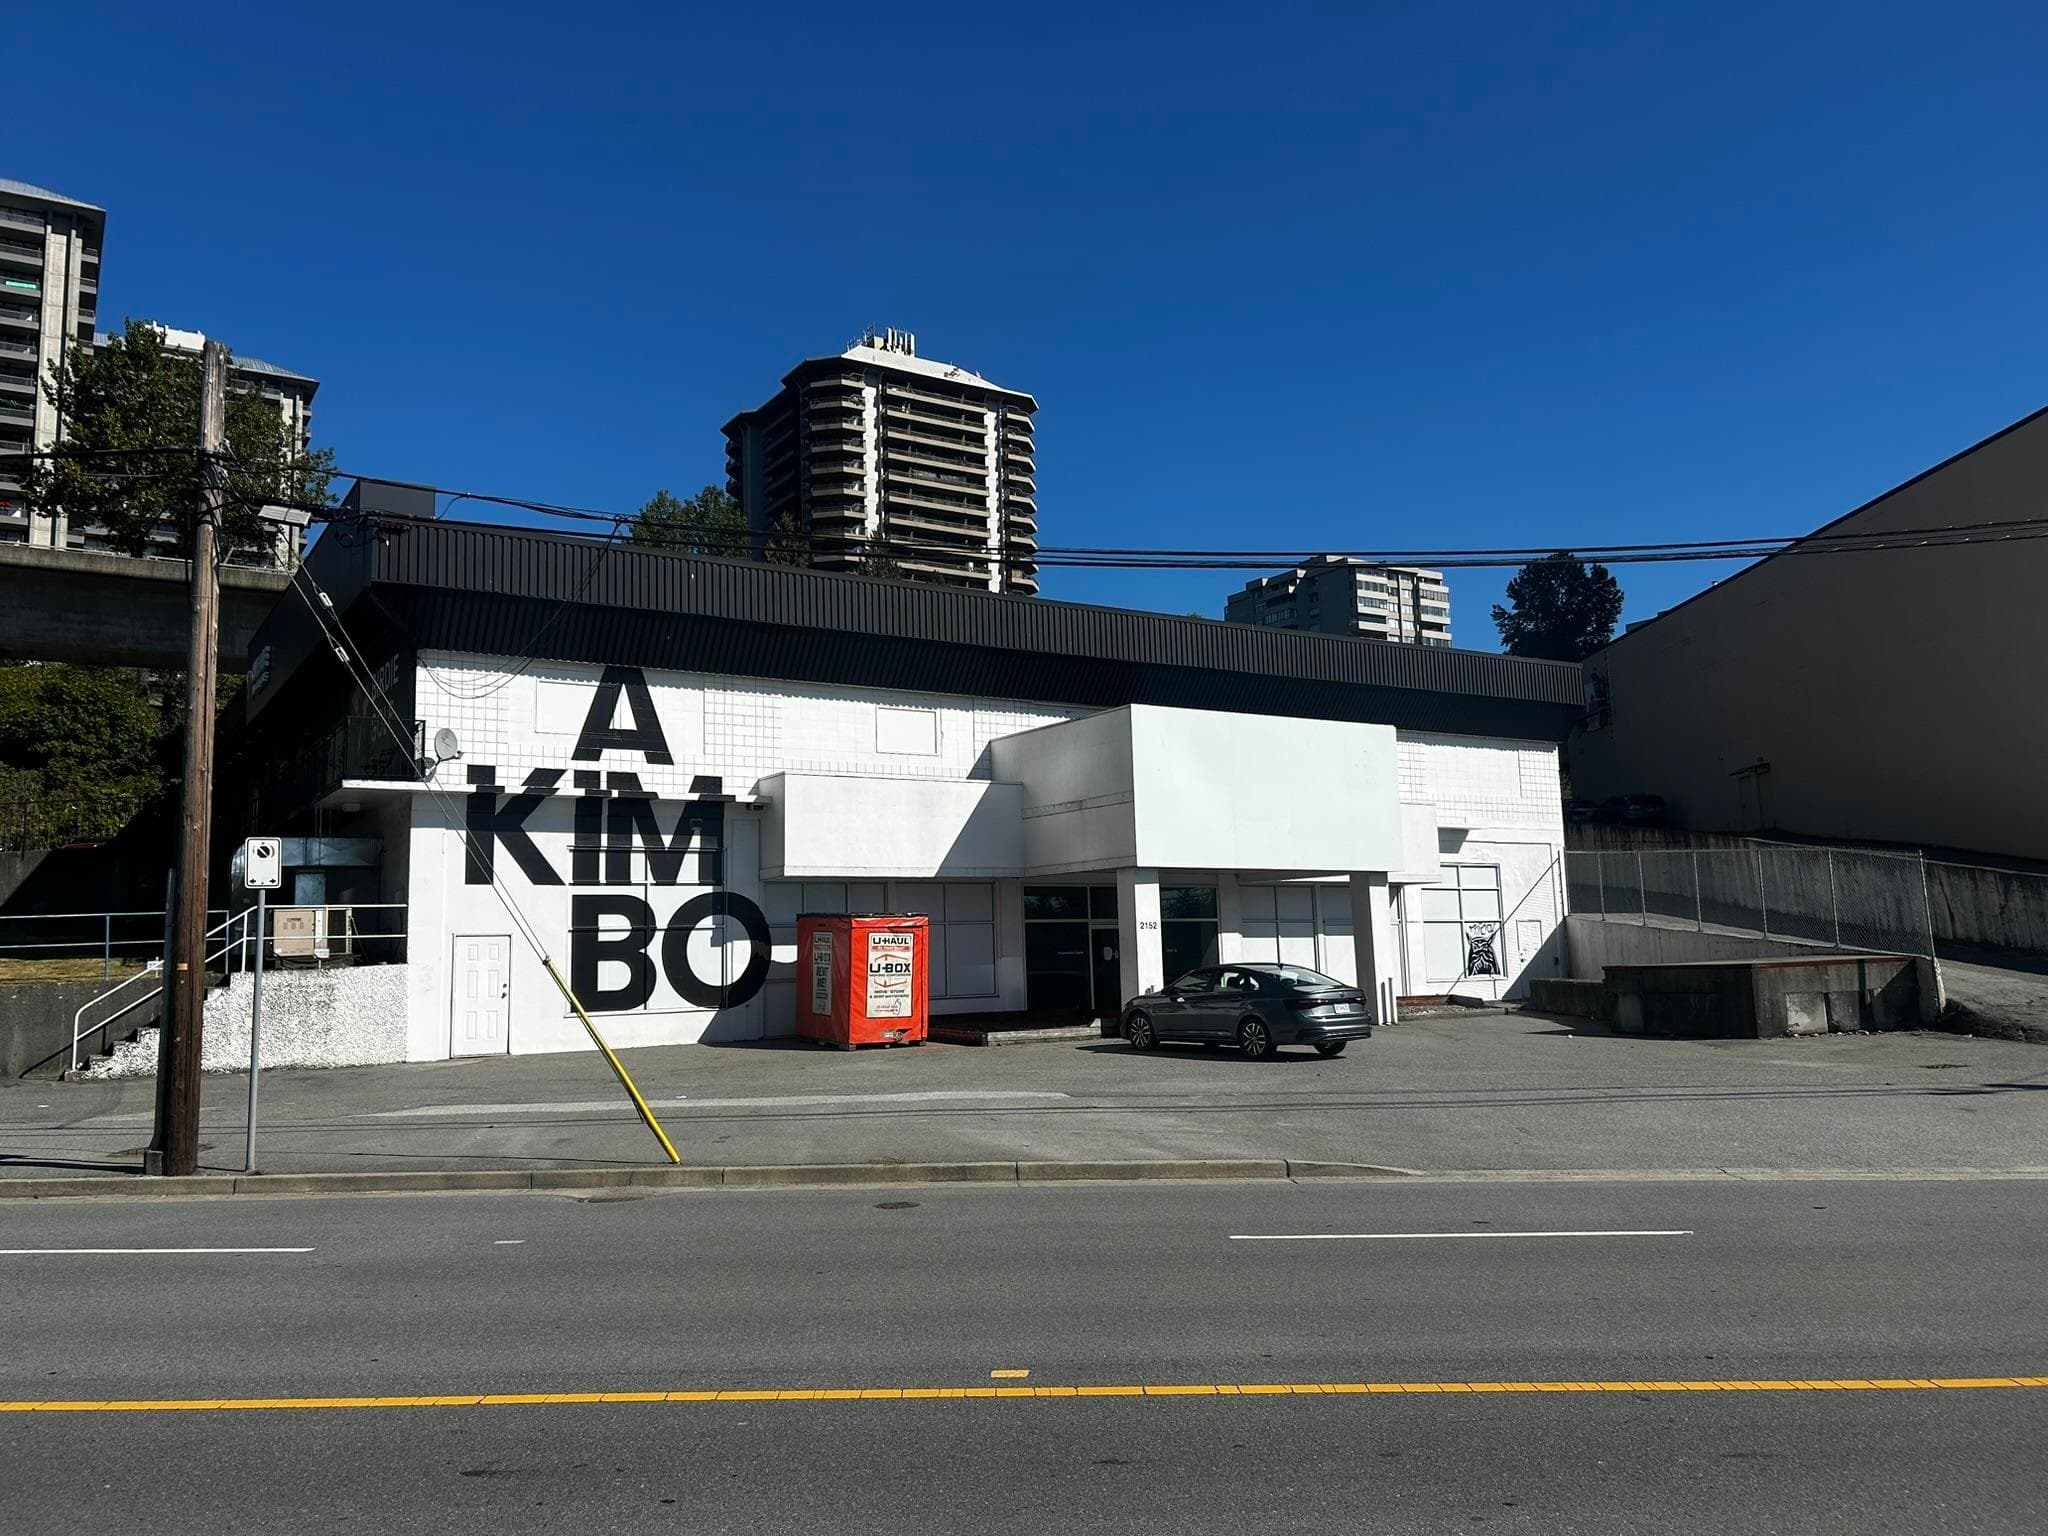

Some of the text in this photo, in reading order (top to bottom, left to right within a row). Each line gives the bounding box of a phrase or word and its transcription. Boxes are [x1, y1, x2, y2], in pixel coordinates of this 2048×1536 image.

[571, 665, 675, 766] A
[465, 764, 725, 886] KIM
[570, 891, 772, 1013] BO
[870, 963, 910, 973] U-BOX
